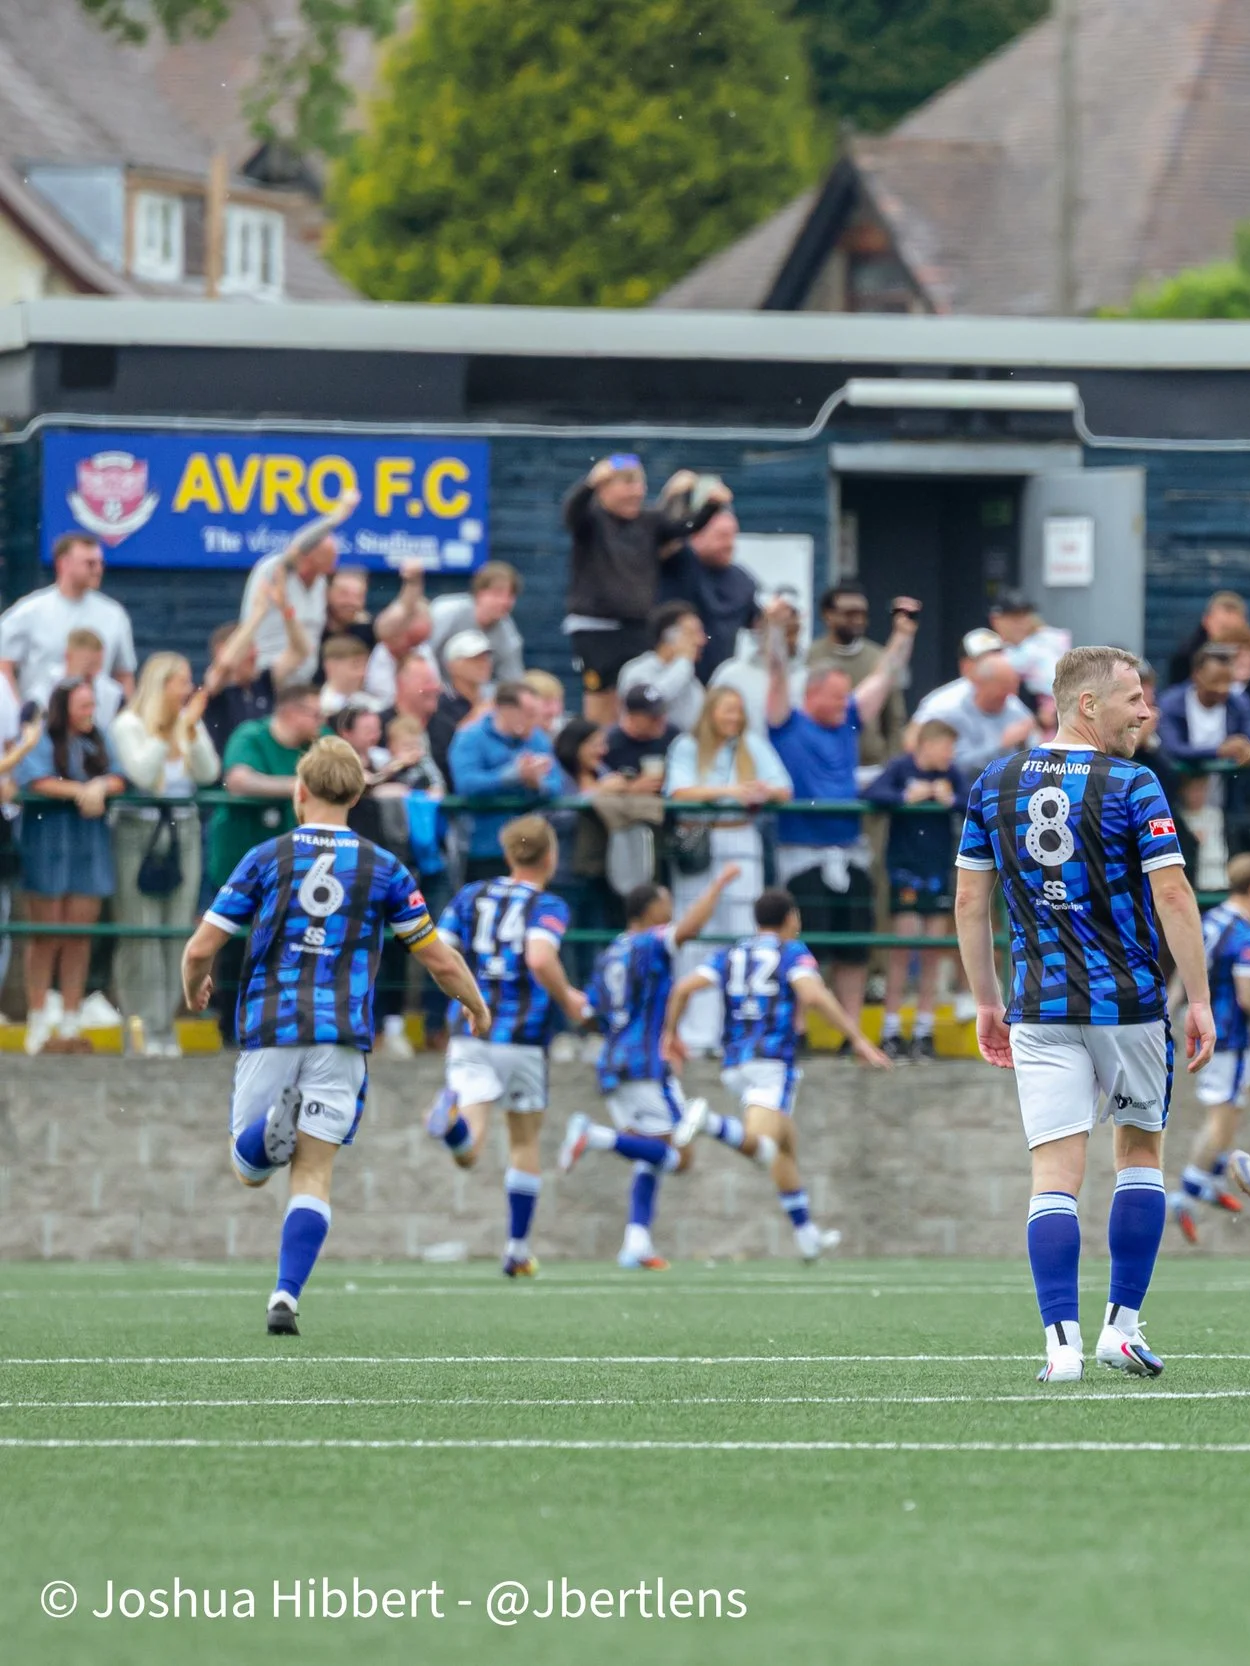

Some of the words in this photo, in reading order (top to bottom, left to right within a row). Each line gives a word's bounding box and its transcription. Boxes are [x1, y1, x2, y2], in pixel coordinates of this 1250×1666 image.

[173, 453, 359, 516] AVRO
[374, 456, 472, 519] F.C
[203, 525, 243, 552] The
[1021, 760, 1091, 775] #TEAMAVRO
[292, 833, 360, 848] #TEAMAVRO
[1025, 786, 1075, 867] 8
[298, 852, 345, 917] 6
[472, 897, 526, 953] 14
[727, 947, 781, 996] 12
